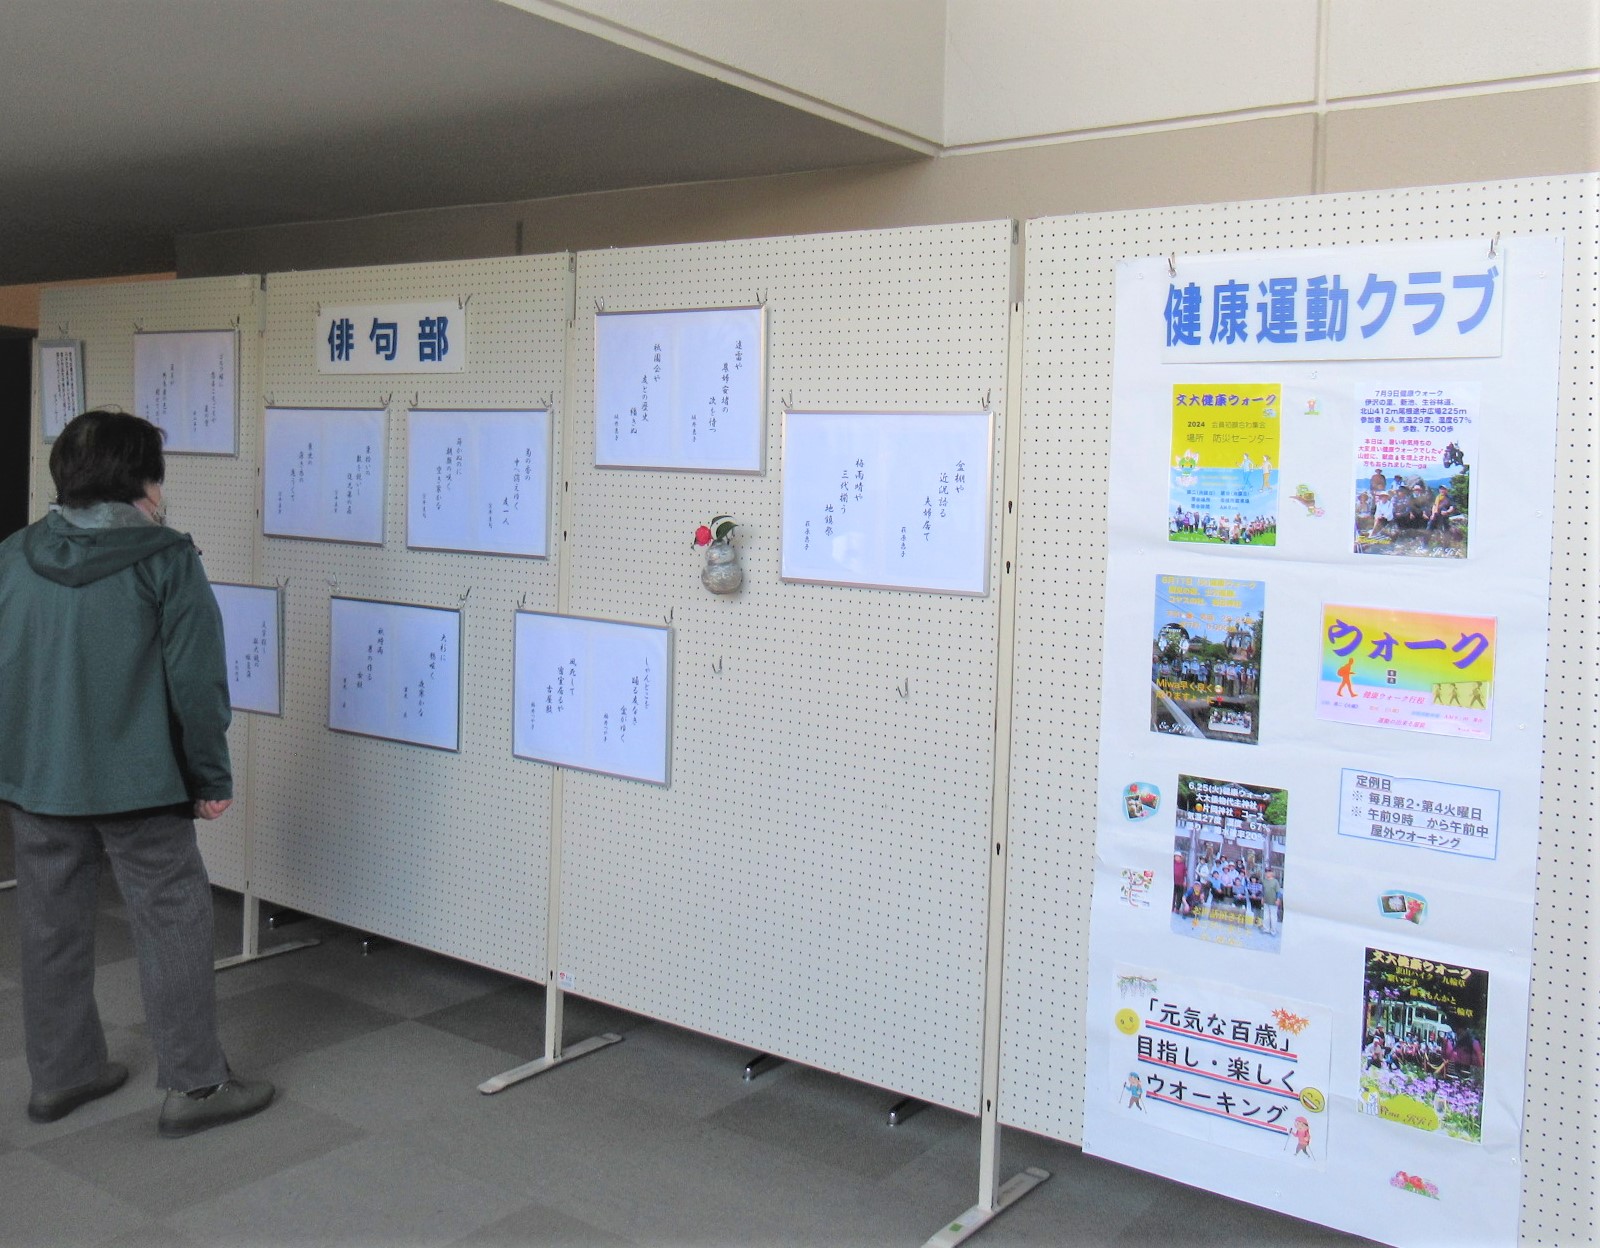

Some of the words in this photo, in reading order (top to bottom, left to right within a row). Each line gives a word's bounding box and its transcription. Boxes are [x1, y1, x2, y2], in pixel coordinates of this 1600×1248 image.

[1163, 266, 1500, 347] 健康運動クラブ
[327, 316, 449, 362] 俳句部
[1176, 393, 1277, 407] 文大健康ウォーク
[1186, 433, 1204, 443] 場所
[839, 470, 849, 514] 三代揃う
[938, 472, 949, 518] 近況語る
[1327, 618, 1489, 670] ウォーク
[1356, 774, 1392, 790] 定例日
[1241, 810, 1265, 821] コース
[1367, 808, 1414, 826] 午前9時
[1426, 817, 1489, 838] から午前中
[1368, 792, 1482, 821] 毎月第2・第4火曜日
[1370, 824, 1461, 848] 屋外ウオーキング
[1150, 998, 1290, 1052] 「元気な百歳」
[1137, 1035, 1295, 1092] 目指し・楽しく
[1147, 1074, 1289, 1123] ウオーキング
